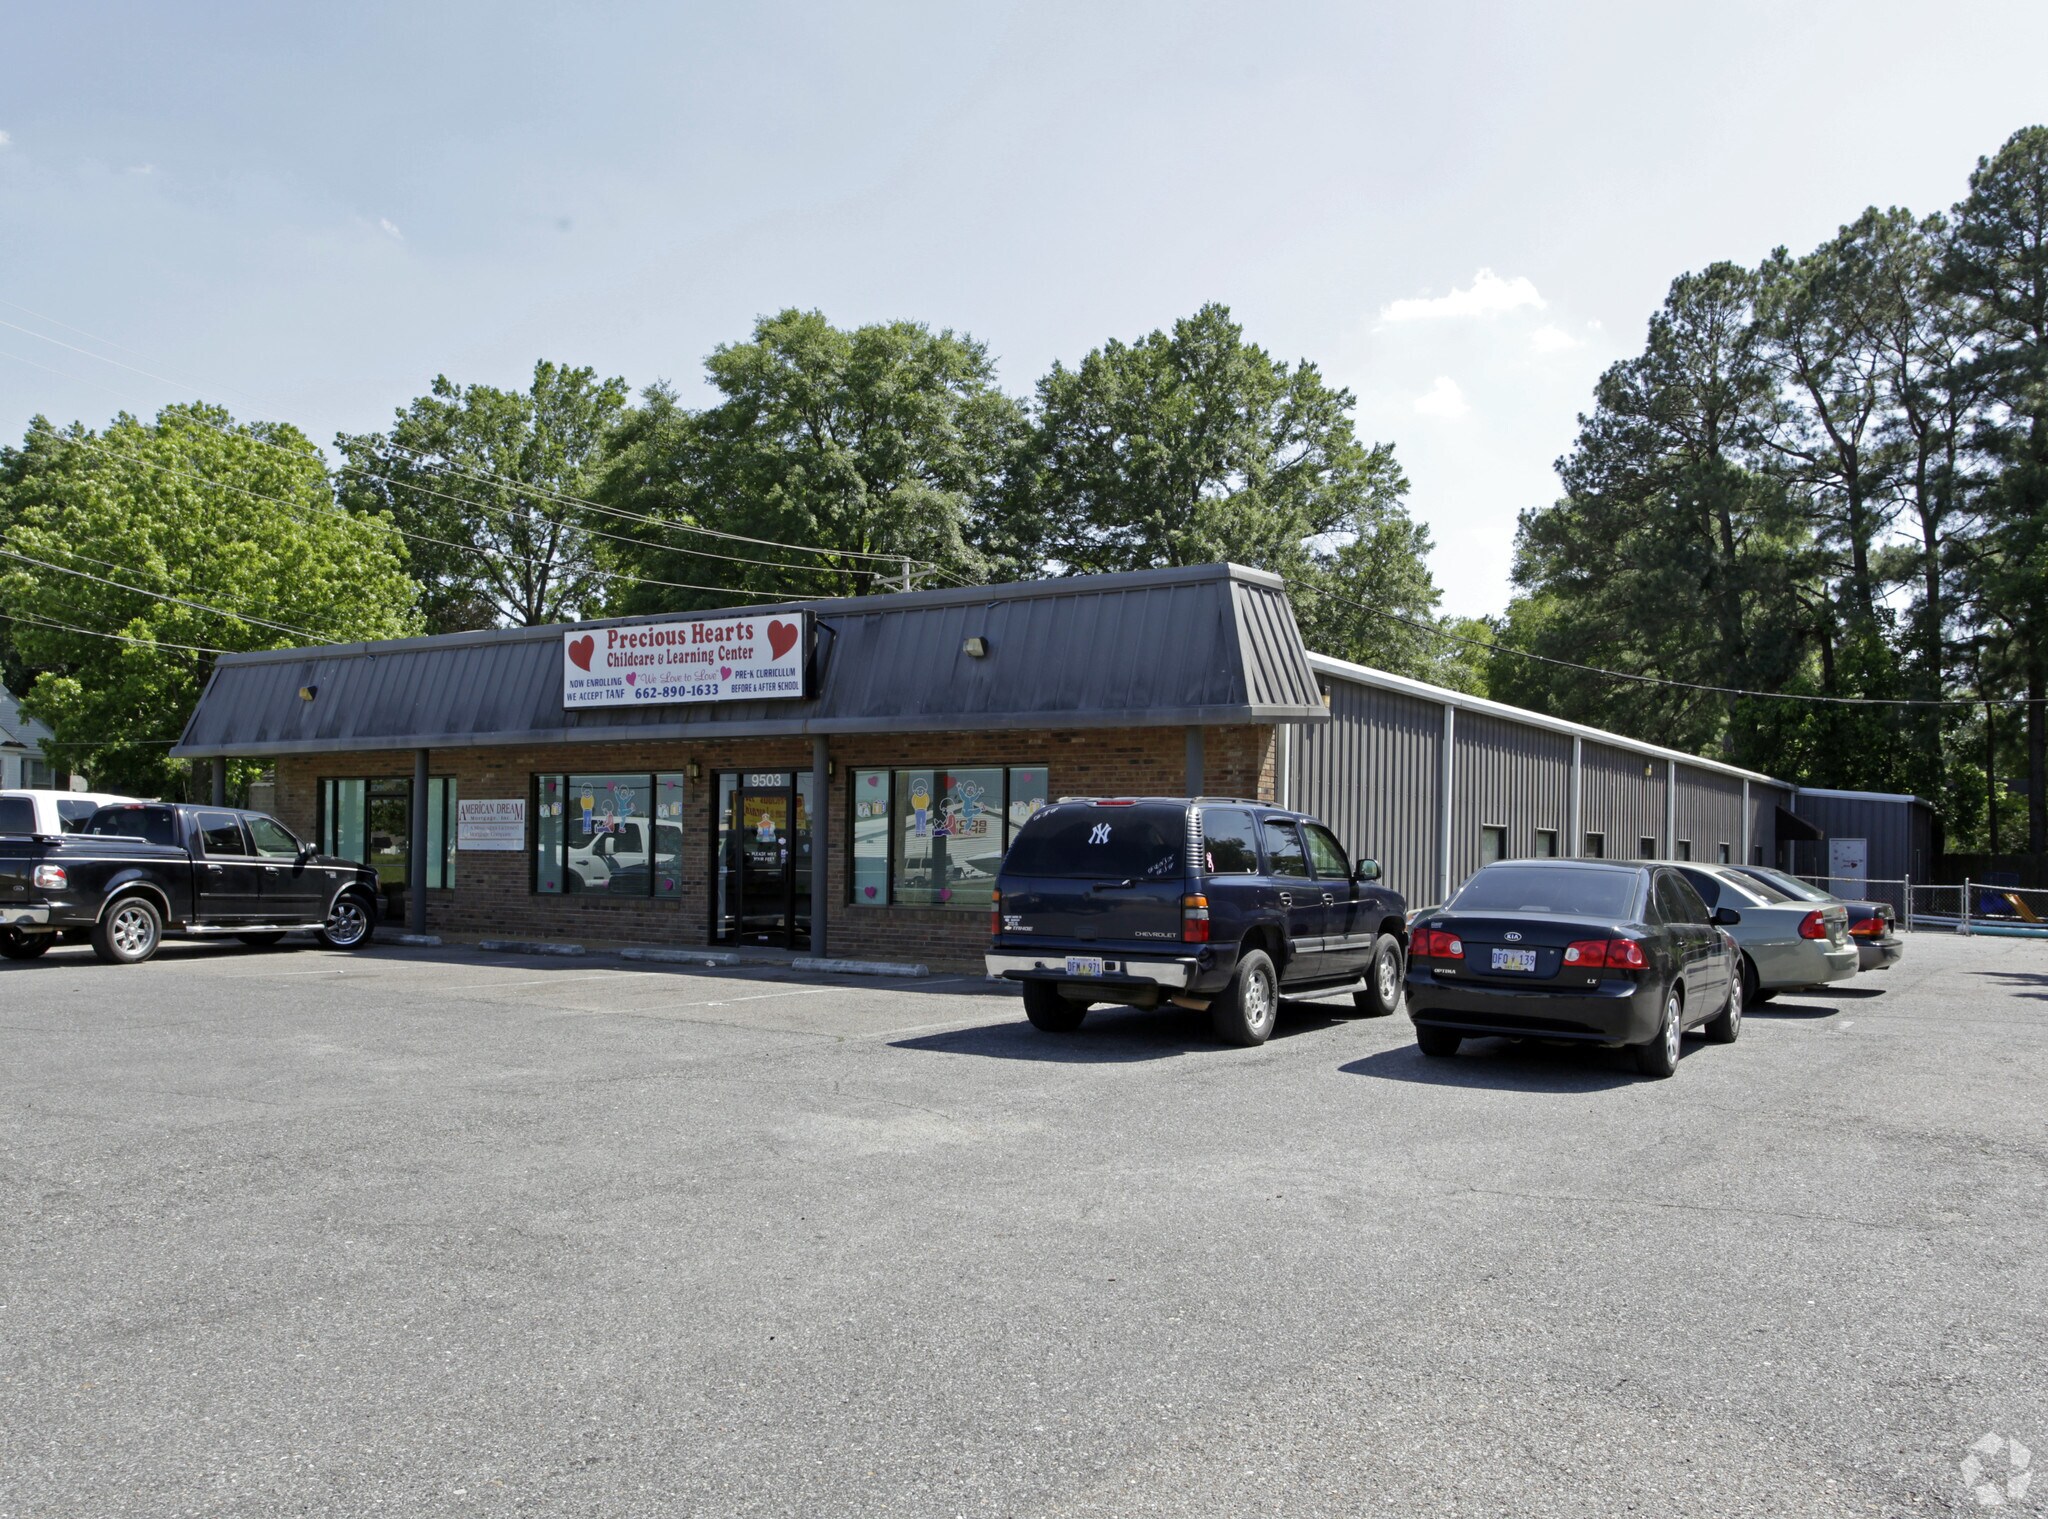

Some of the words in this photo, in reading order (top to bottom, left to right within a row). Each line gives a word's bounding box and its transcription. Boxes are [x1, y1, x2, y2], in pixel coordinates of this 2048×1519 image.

[607, 627, 686, 649] Precious
[691, 621, 754, 644] Hearts
[607, 652, 655, 667] Childcare
[658, 654, 664, 665] &
[666, 647, 714, 666] Learning
[718, 645, 754, 661] Center
[660, 671, 682, 683] Love
[684, 672, 692, 681] to
[735, 670, 754, 679] PRE-K
[756, 667, 796, 678] CURRICULUM
[569, 680, 585, 688] NOW
[586, 677, 622, 688] ENROLLING
[731, 683, 752, 693] BEFORE
[758, 682, 776, 691] AFTER
[777, 681, 799, 691] SCHOOL
[567, 692, 577, 701] WE
[579, 691, 603, 700] ACCEPT
[606, 689, 625, 699] TANF
[635, 683, 719, 699] 662-890-1633
[751, 774, 782, 787] 9503
[459, 803, 494, 820] AMERICAN
[496, 803, 523, 820] DREAM
[1519, 954, 1535, 967] 139
